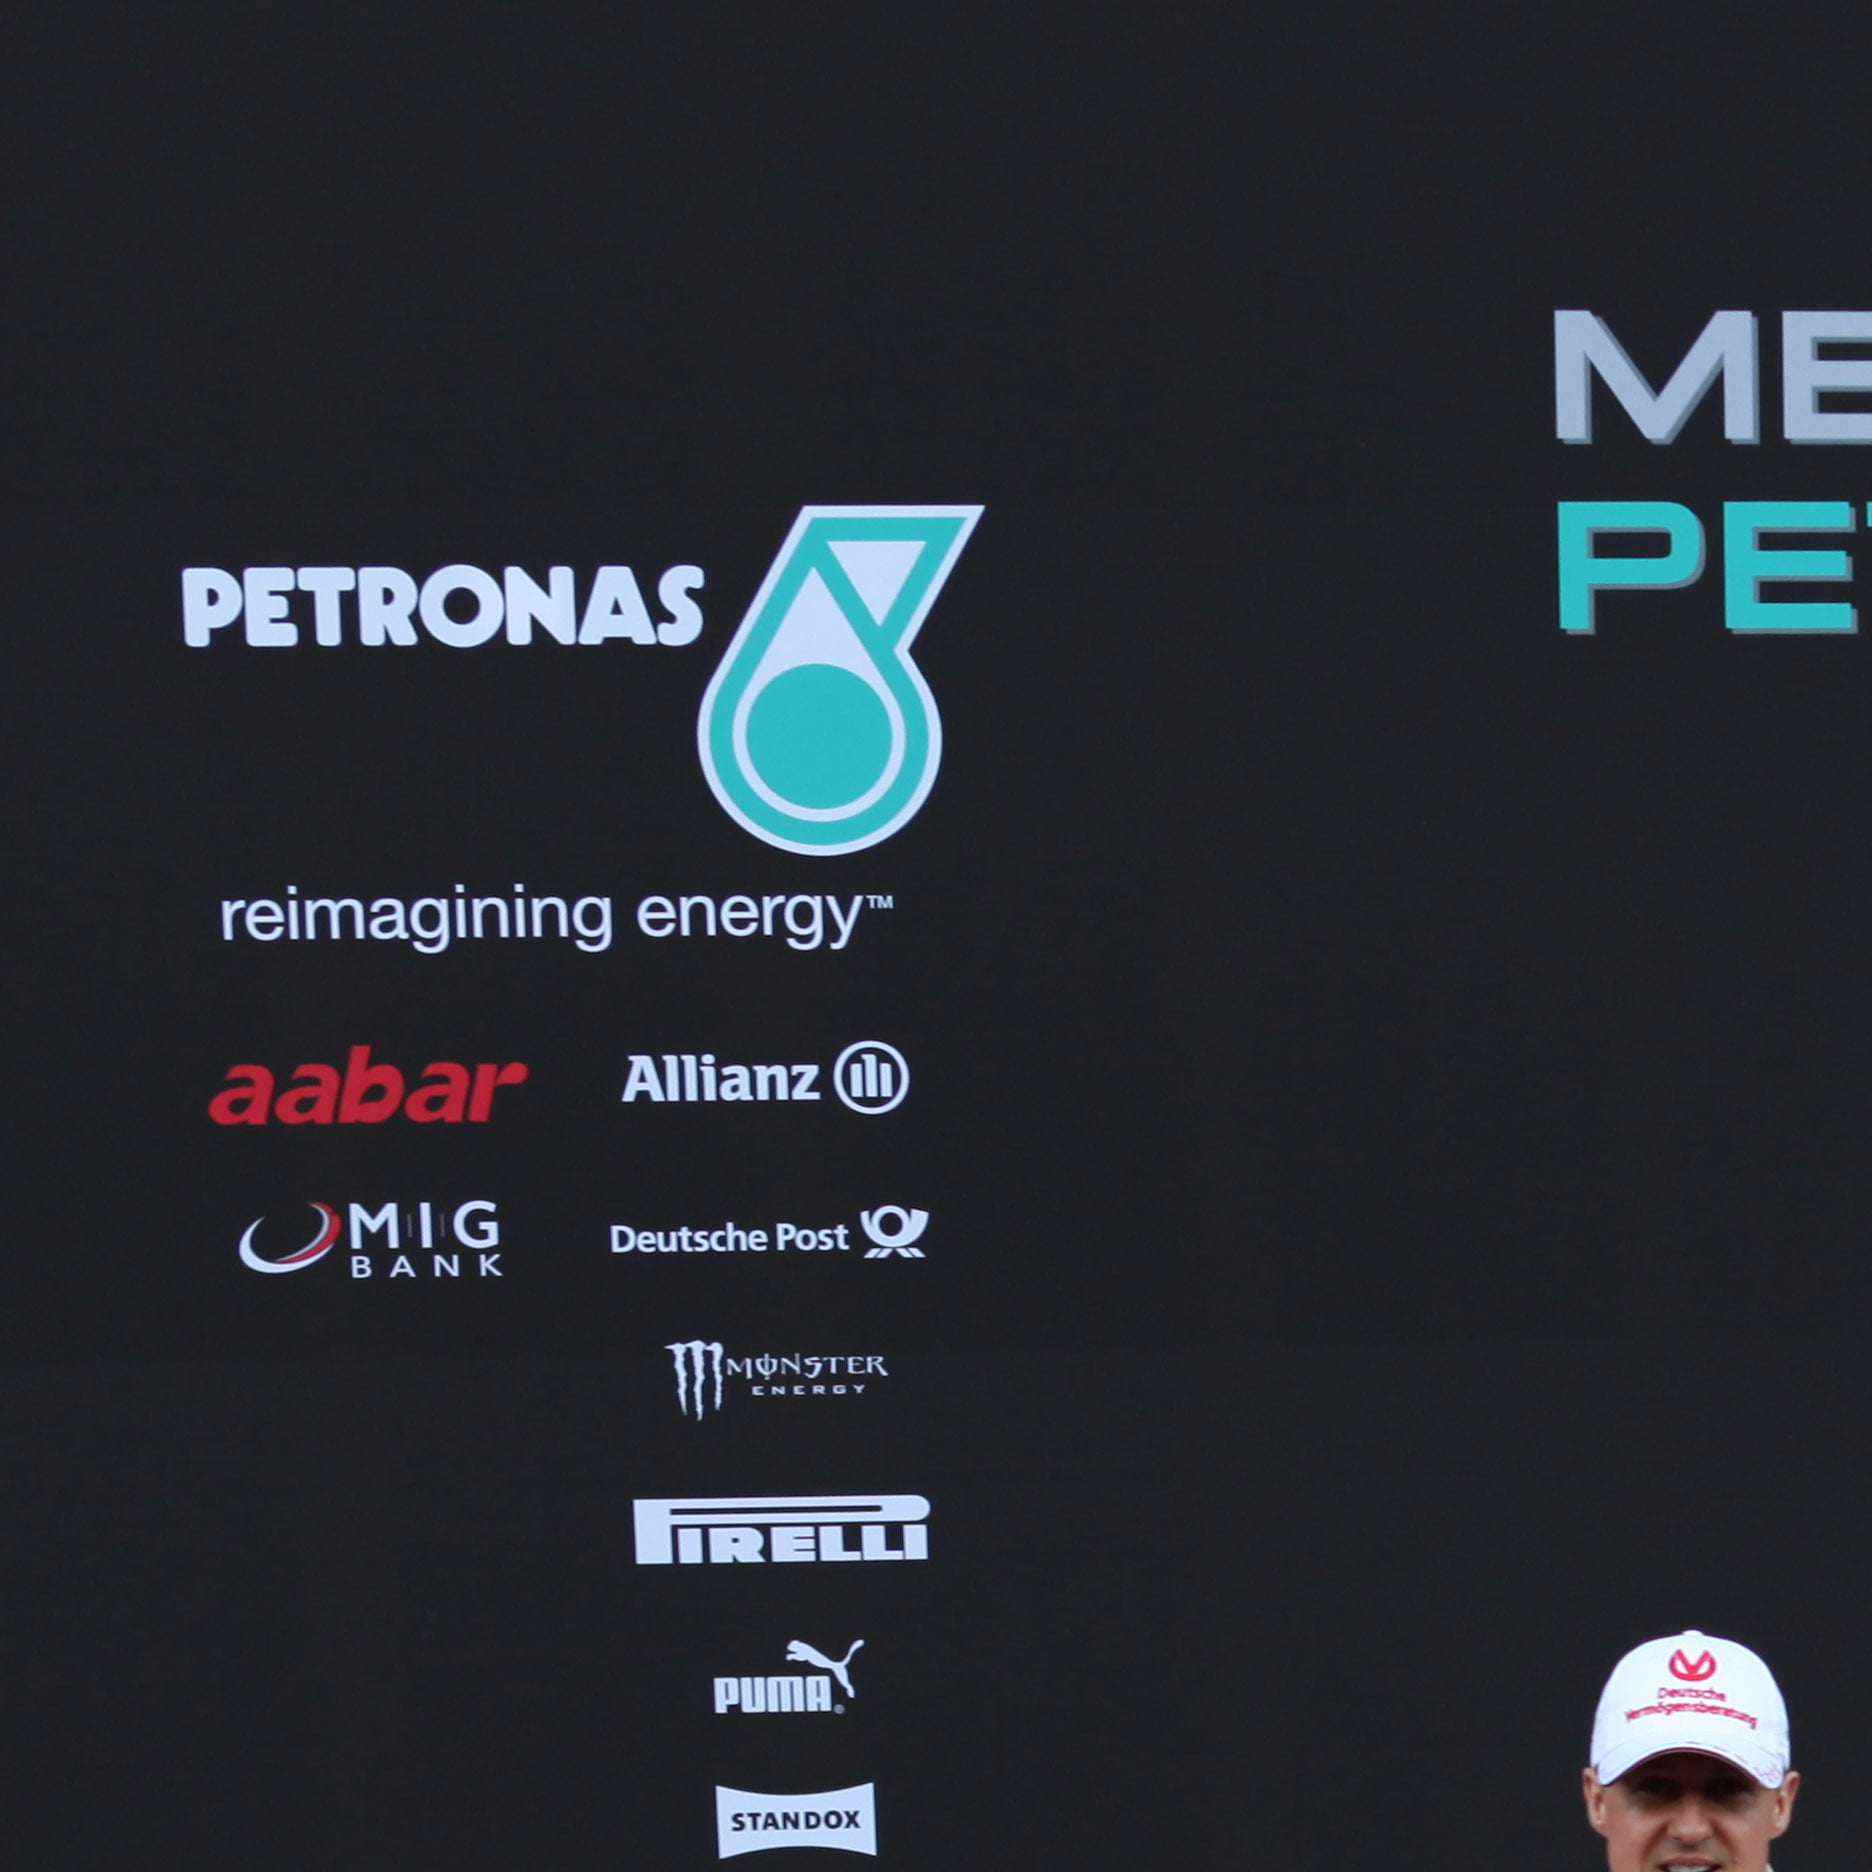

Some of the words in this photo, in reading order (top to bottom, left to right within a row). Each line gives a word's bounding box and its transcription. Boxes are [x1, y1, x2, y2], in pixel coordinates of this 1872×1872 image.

[181, 563, 705, 648] PETRONAS
[221, 883, 612, 954] reimagining
[208, 1045, 529, 1125] aabar
[621, 1053, 821, 1102] Allianz
[348, 1200, 501, 1250] MIG
[610, 1222, 769, 1253] Deutsche
[775, 1222, 850, 1252] Post
[351, 1255, 502, 1279] BANK
[727, 1353, 888, 1378] MONSTER
[752, 1385, 865, 1395] ENERGY
[632, 1494, 931, 1565] PIRELLI
[713, 1676, 833, 1714] PUMA
[731, 1808, 861, 1832] STANDOX
